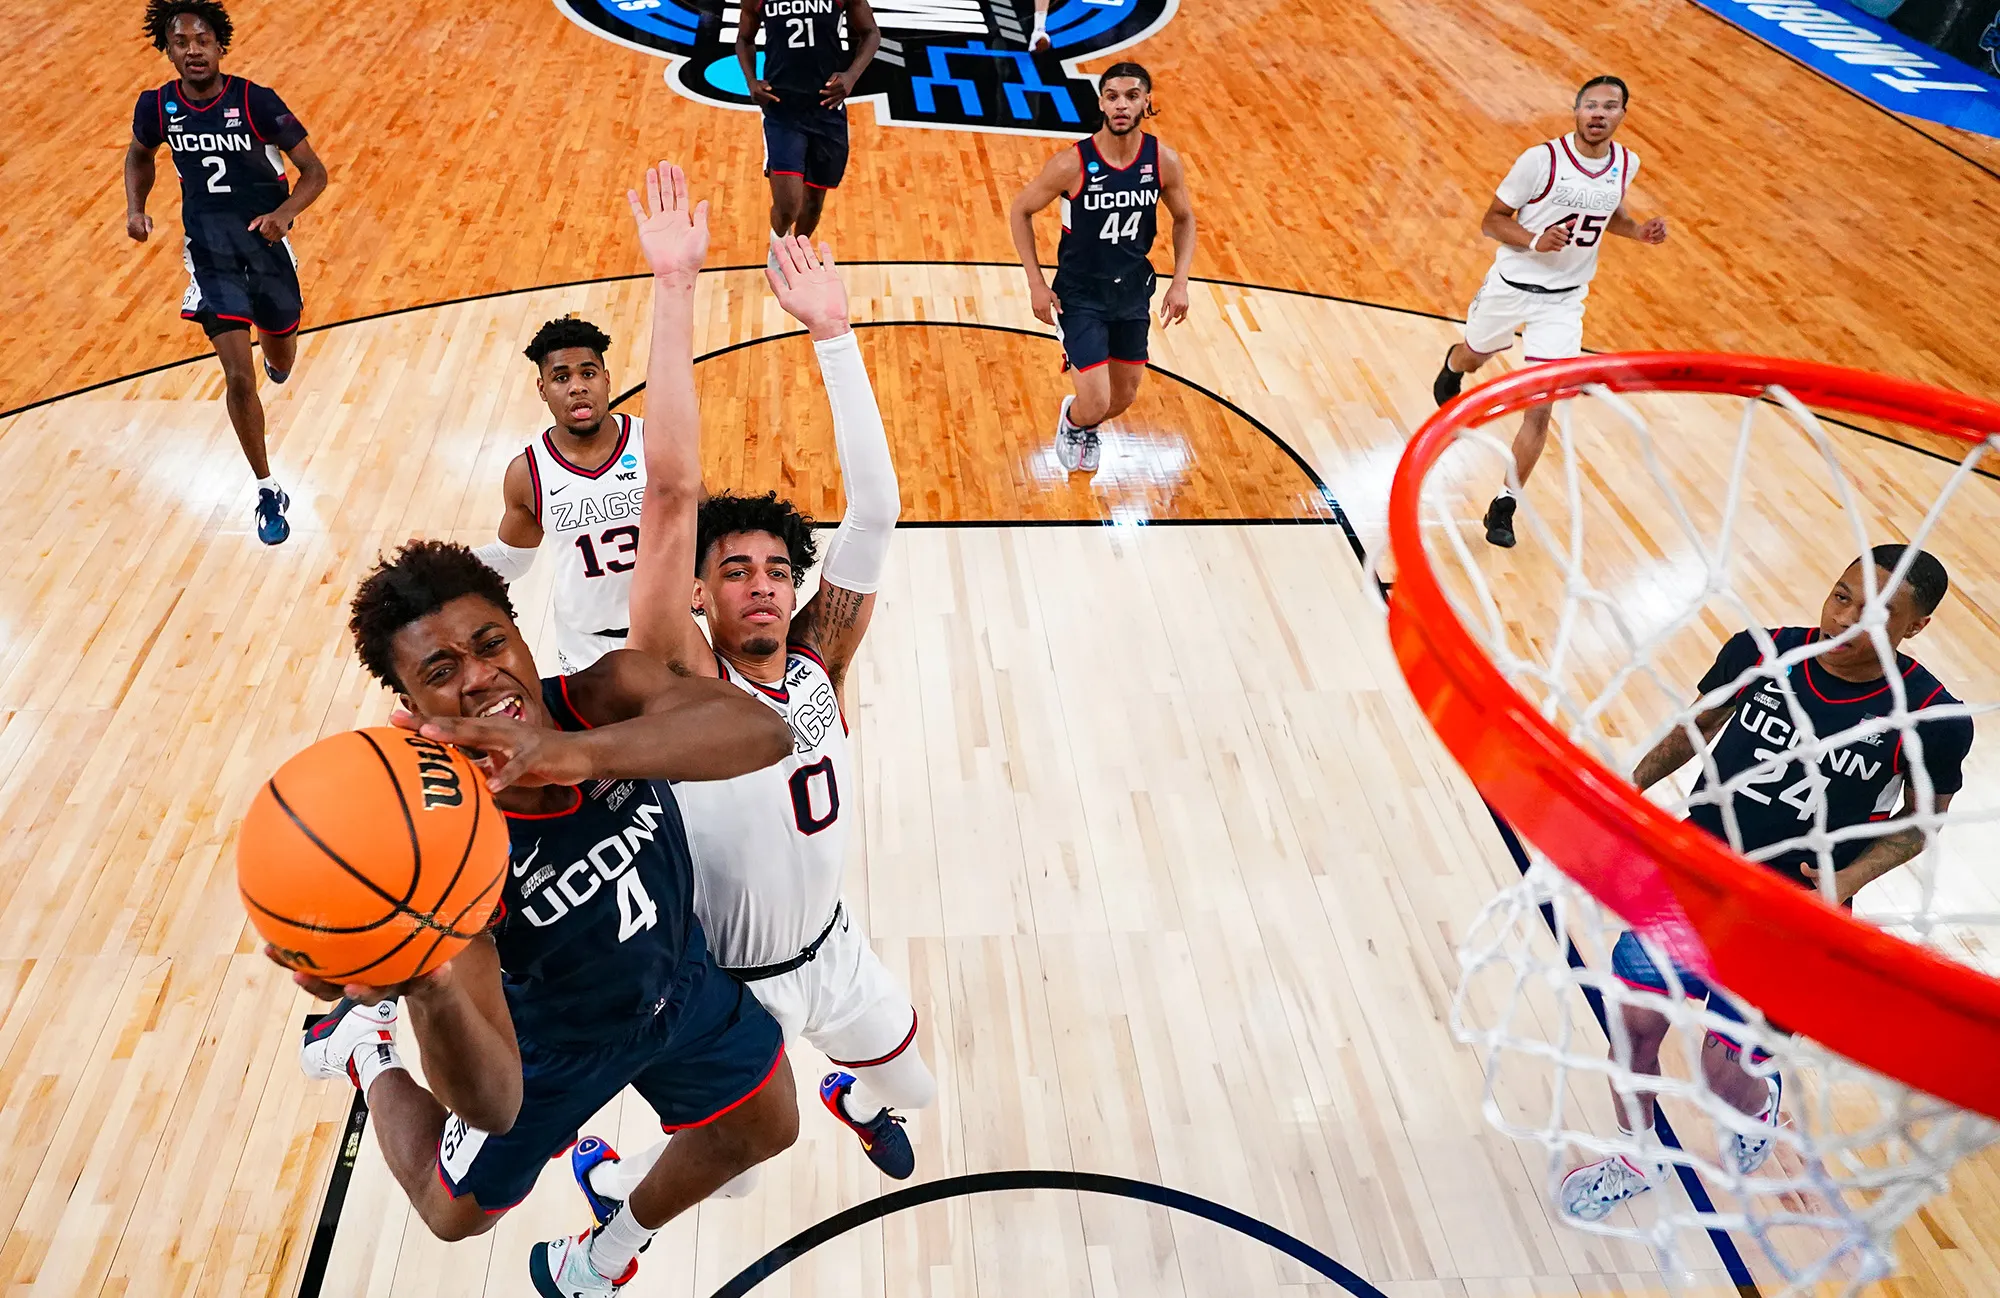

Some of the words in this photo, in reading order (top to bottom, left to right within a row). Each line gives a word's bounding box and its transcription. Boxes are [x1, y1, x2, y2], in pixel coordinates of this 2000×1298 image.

[764, 0, 833, 17] UCONN
[786, 18, 815, 48] 21
[168, 133, 252, 152] UCONN
[201, 156, 232, 193] 2
[1084, 189, 1159, 211] UCONN
[1552, 185, 1619, 211] ZAGS
[1099, 211, 1142, 244] 44
[615, 471, 637, 481] WCC
[550, 486, 646, 532] ZAGS
[575, 525, 640, 578] 13
[786, 665, 812, 687] WCC
[788, 754, 840, 836] 0
[1735, 747, 1831, 821] 24
[521, 786, 664, 927] UCONN
[617, 866, 657, 943] 4
